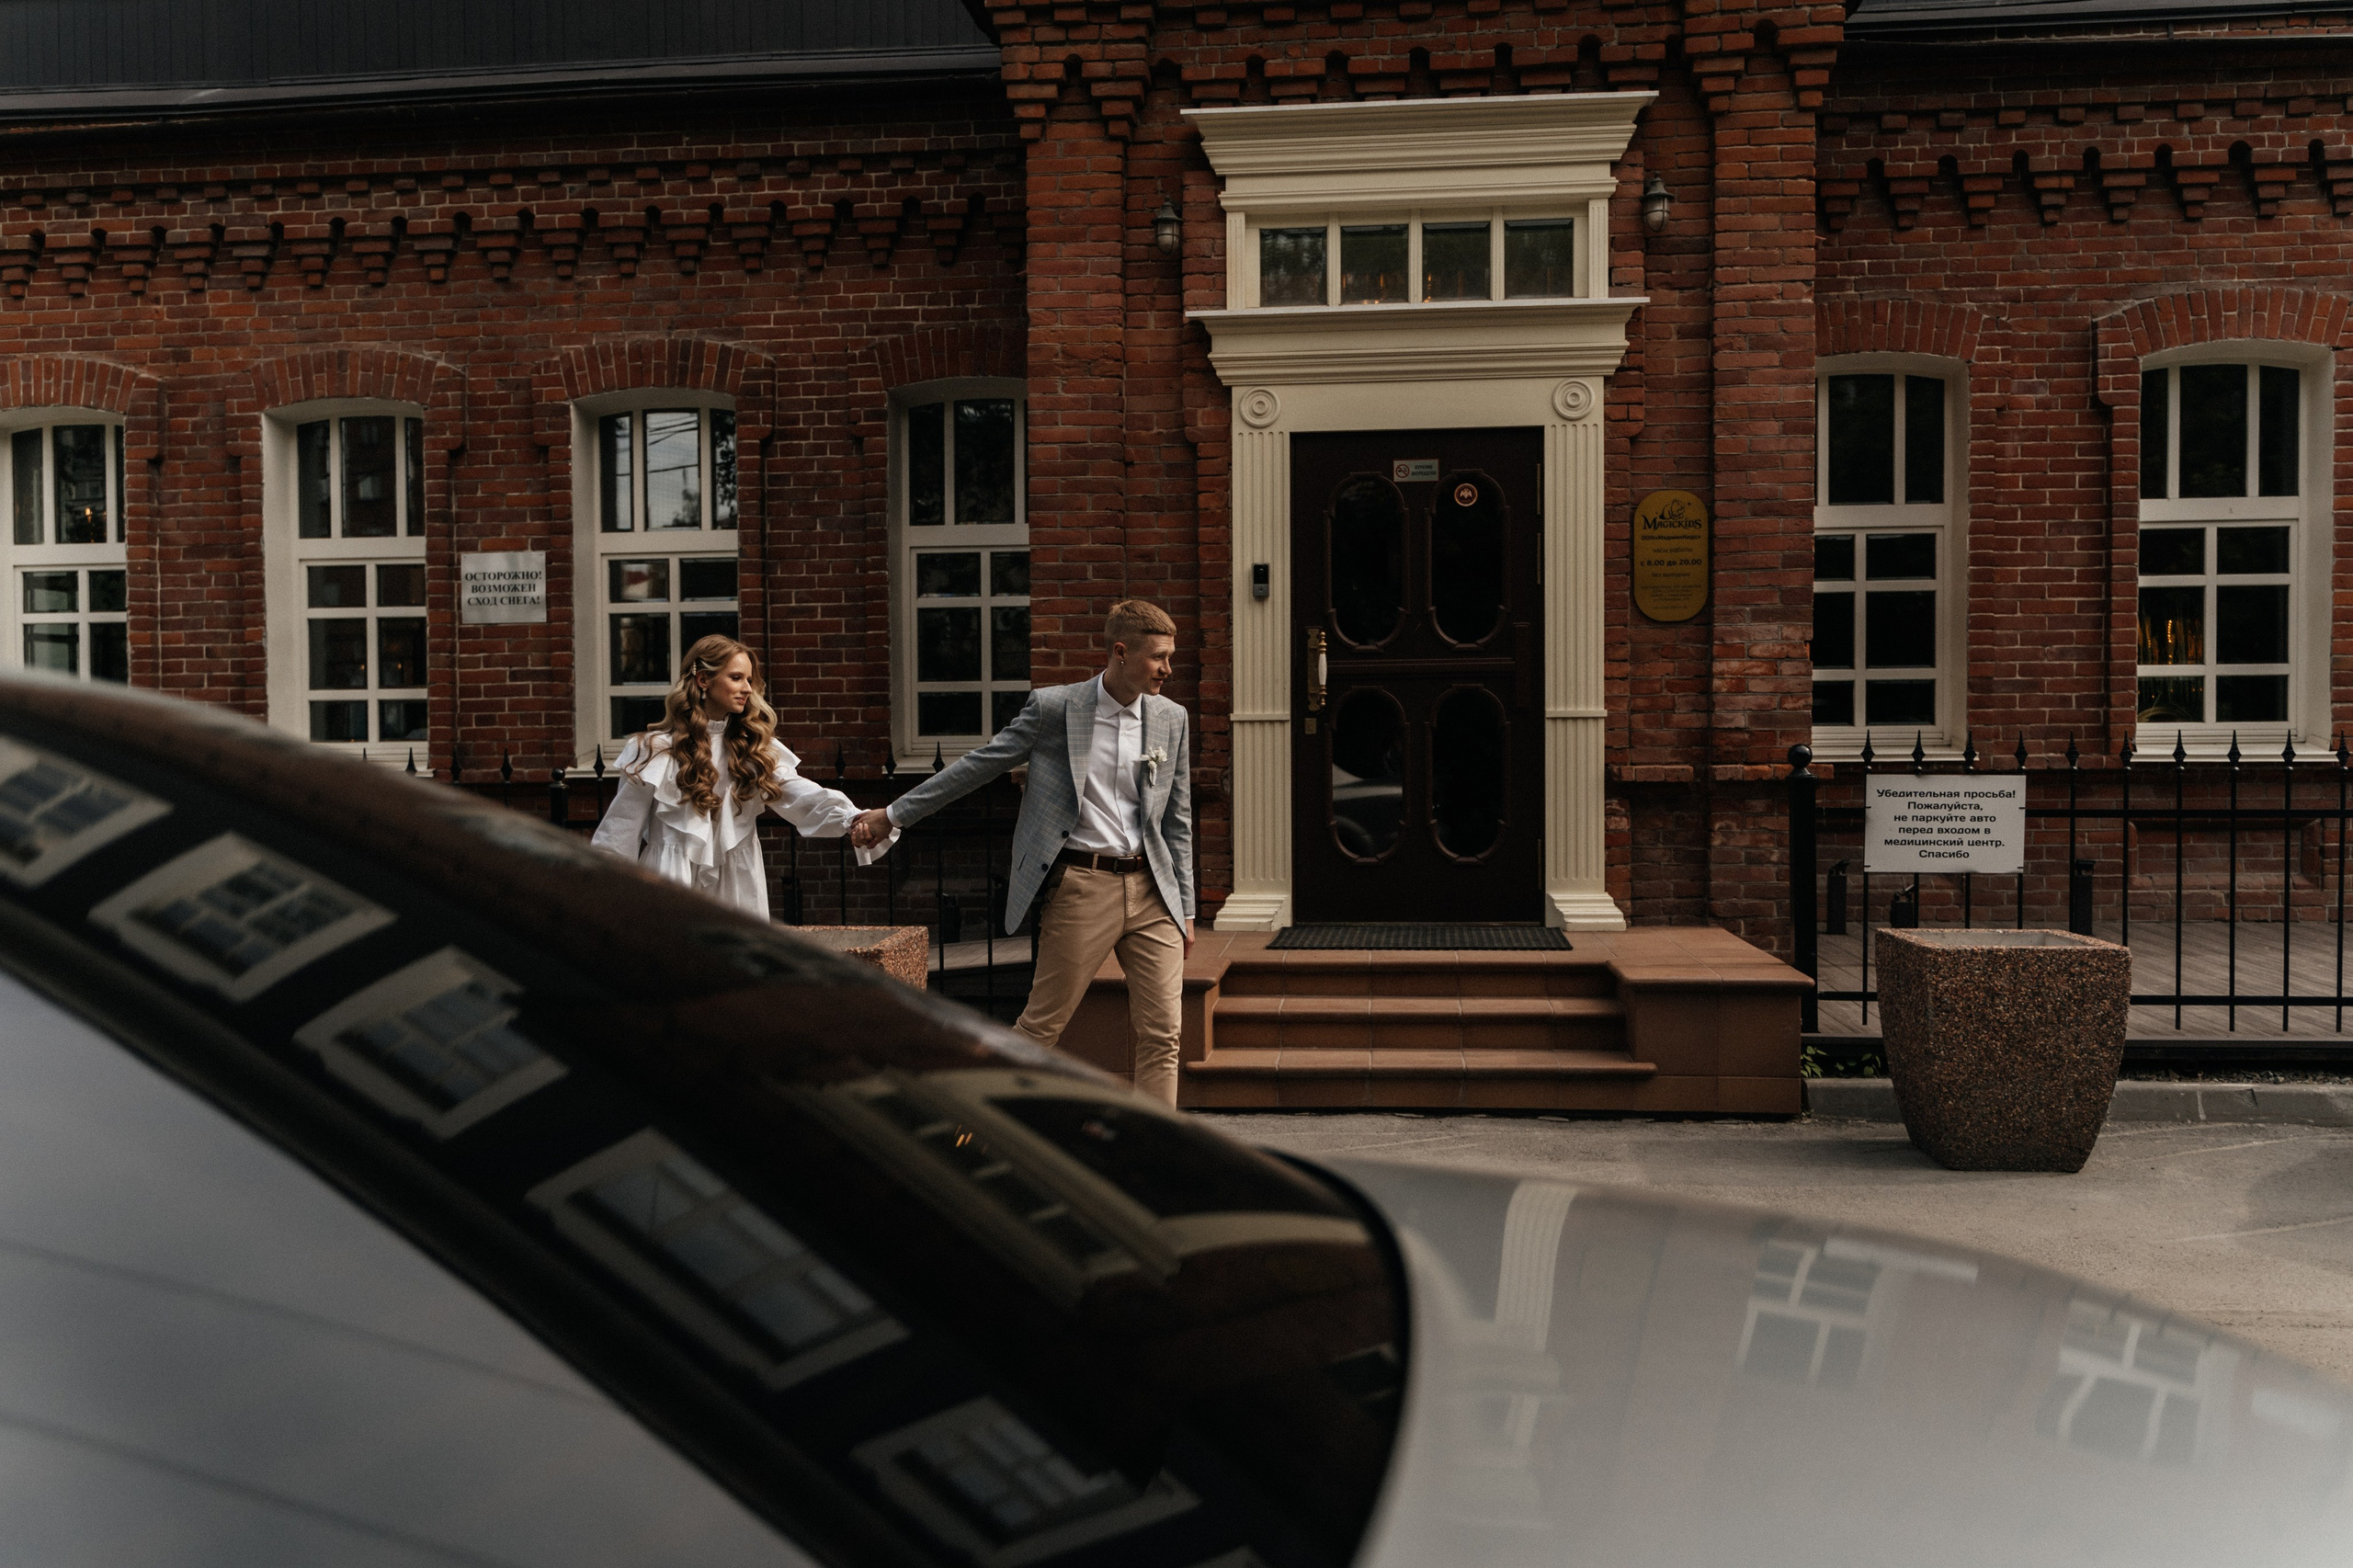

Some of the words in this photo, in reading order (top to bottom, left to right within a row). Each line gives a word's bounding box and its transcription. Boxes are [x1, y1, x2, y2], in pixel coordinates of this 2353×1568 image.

[1646, 559, 1665, 567] 8.00
[1678, 558, 1702, 566] 20.00
[464, 571, 542, 581] ОСТОРОЖНО!
[471, 584, 537, 594] ВОЗМОЖЕН
[467, 597, 498, 607] СХОД
[500, 596, 540, 606] СНЕГА!
[1876, 789, 1961, 799] Убедительная
[1963, 790, 2016, 800] просьба!
[1907, 801, 1984, 812] Пожалуйста,
[1911, 813, 1966, 824] паркуйте
[1898, 827, 1934, 835] перед
[1884, 837, 1964, 846] медицинский
[1967, 839, 2006, 848] центр.
[1918, 849, 1970, 858] Спасибо
